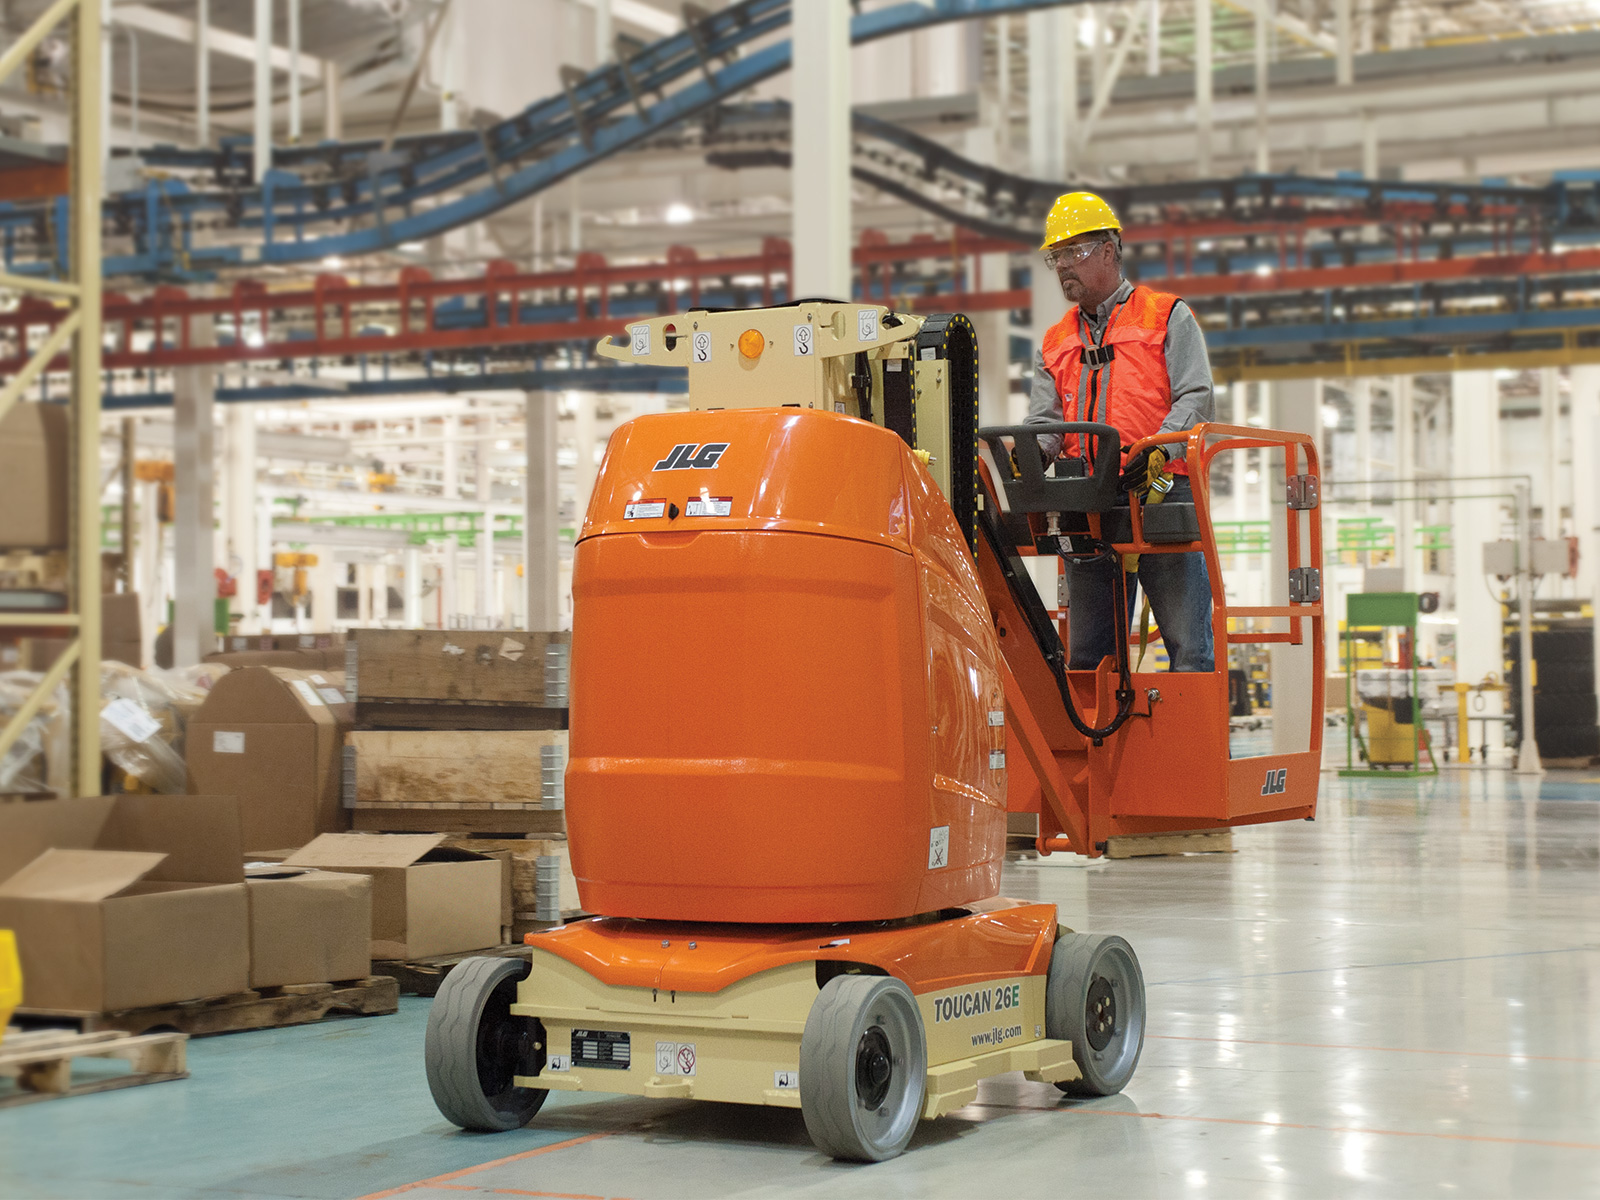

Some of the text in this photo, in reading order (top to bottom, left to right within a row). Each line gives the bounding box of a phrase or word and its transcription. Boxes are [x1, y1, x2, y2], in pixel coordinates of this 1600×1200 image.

[652, 443, 730, 471] JLG
[1261, 768, 1287, 796] JLG
[934, 984, 1019, 1022] TOUCAN 26E
[971, 1025, 1021, 1046] www.jlg.com
